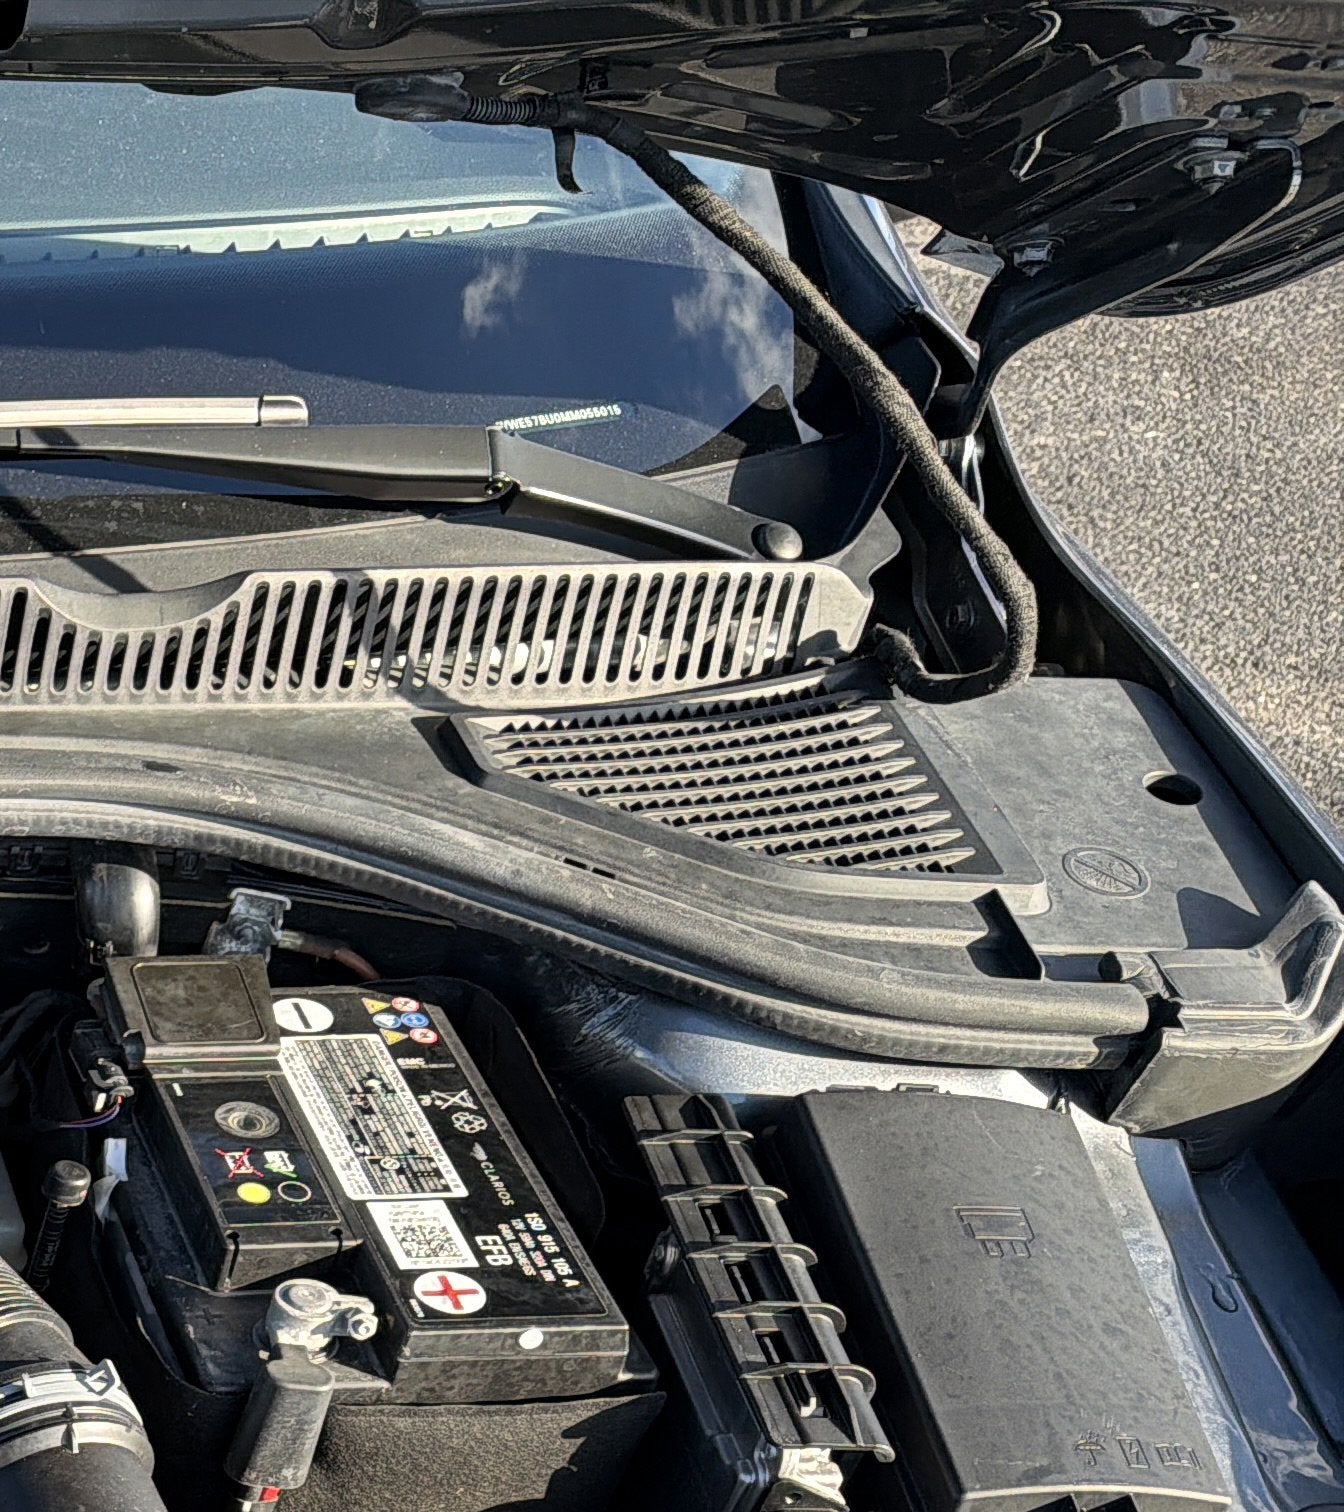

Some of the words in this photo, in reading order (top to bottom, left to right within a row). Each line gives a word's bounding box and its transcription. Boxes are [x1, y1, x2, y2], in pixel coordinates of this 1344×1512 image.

[480, 1161, 515, 1206] CLARIOS
[475, 1235, 514, 1266] EFB
[537, 1234, 560, 1253] 915
[551, 1257, 573, 1276] 105
[562, 1279, 580, 1288] A
